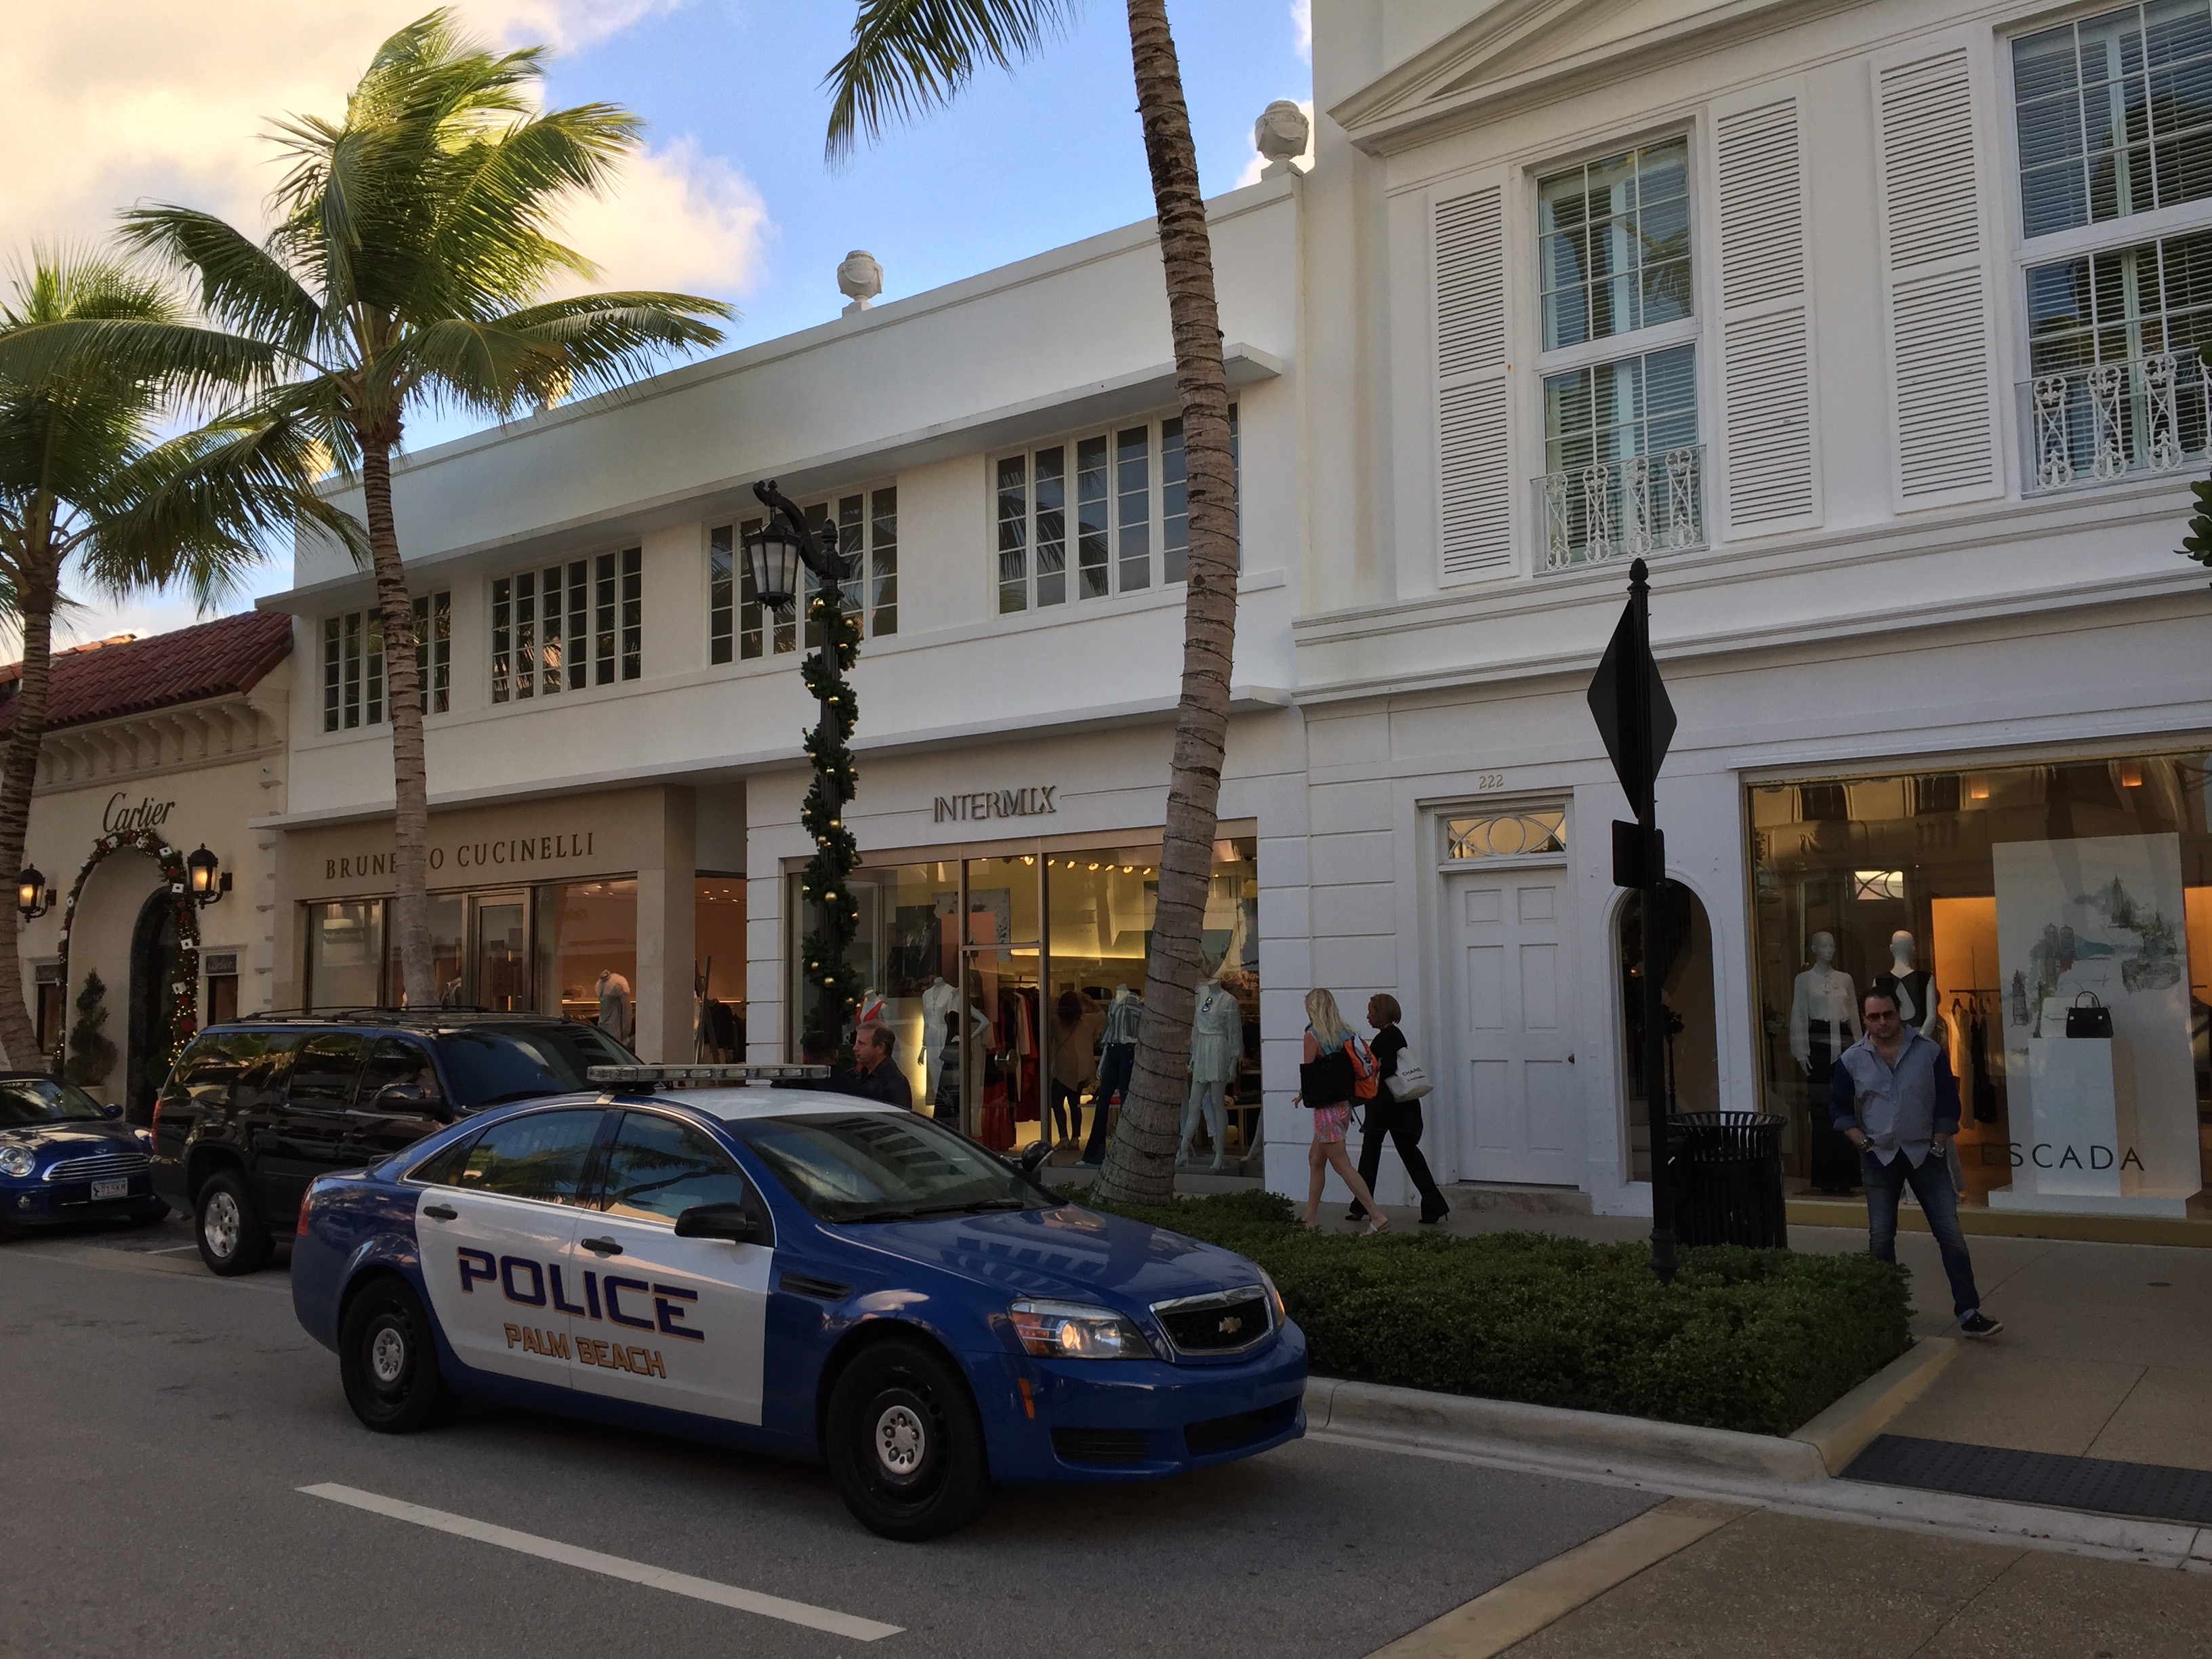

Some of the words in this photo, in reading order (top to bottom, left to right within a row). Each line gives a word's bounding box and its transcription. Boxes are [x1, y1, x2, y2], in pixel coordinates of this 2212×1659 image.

[1479, 774, 1504, 790] 222
[103, 792, 176, 832] Cartier
[934, 785, 1057, 823] INTERMIX
[326, 847, 445, 880] BRUNEO
[457, 832, 594, 868] CUCINELLI
[1981, 1142, 2145, 1171] ESCADA
[456, 1246, 705, 1343] POLICE
[504, 1323, 571, 1360] PALM
[575, 1336, 667, 1378] BEACH
